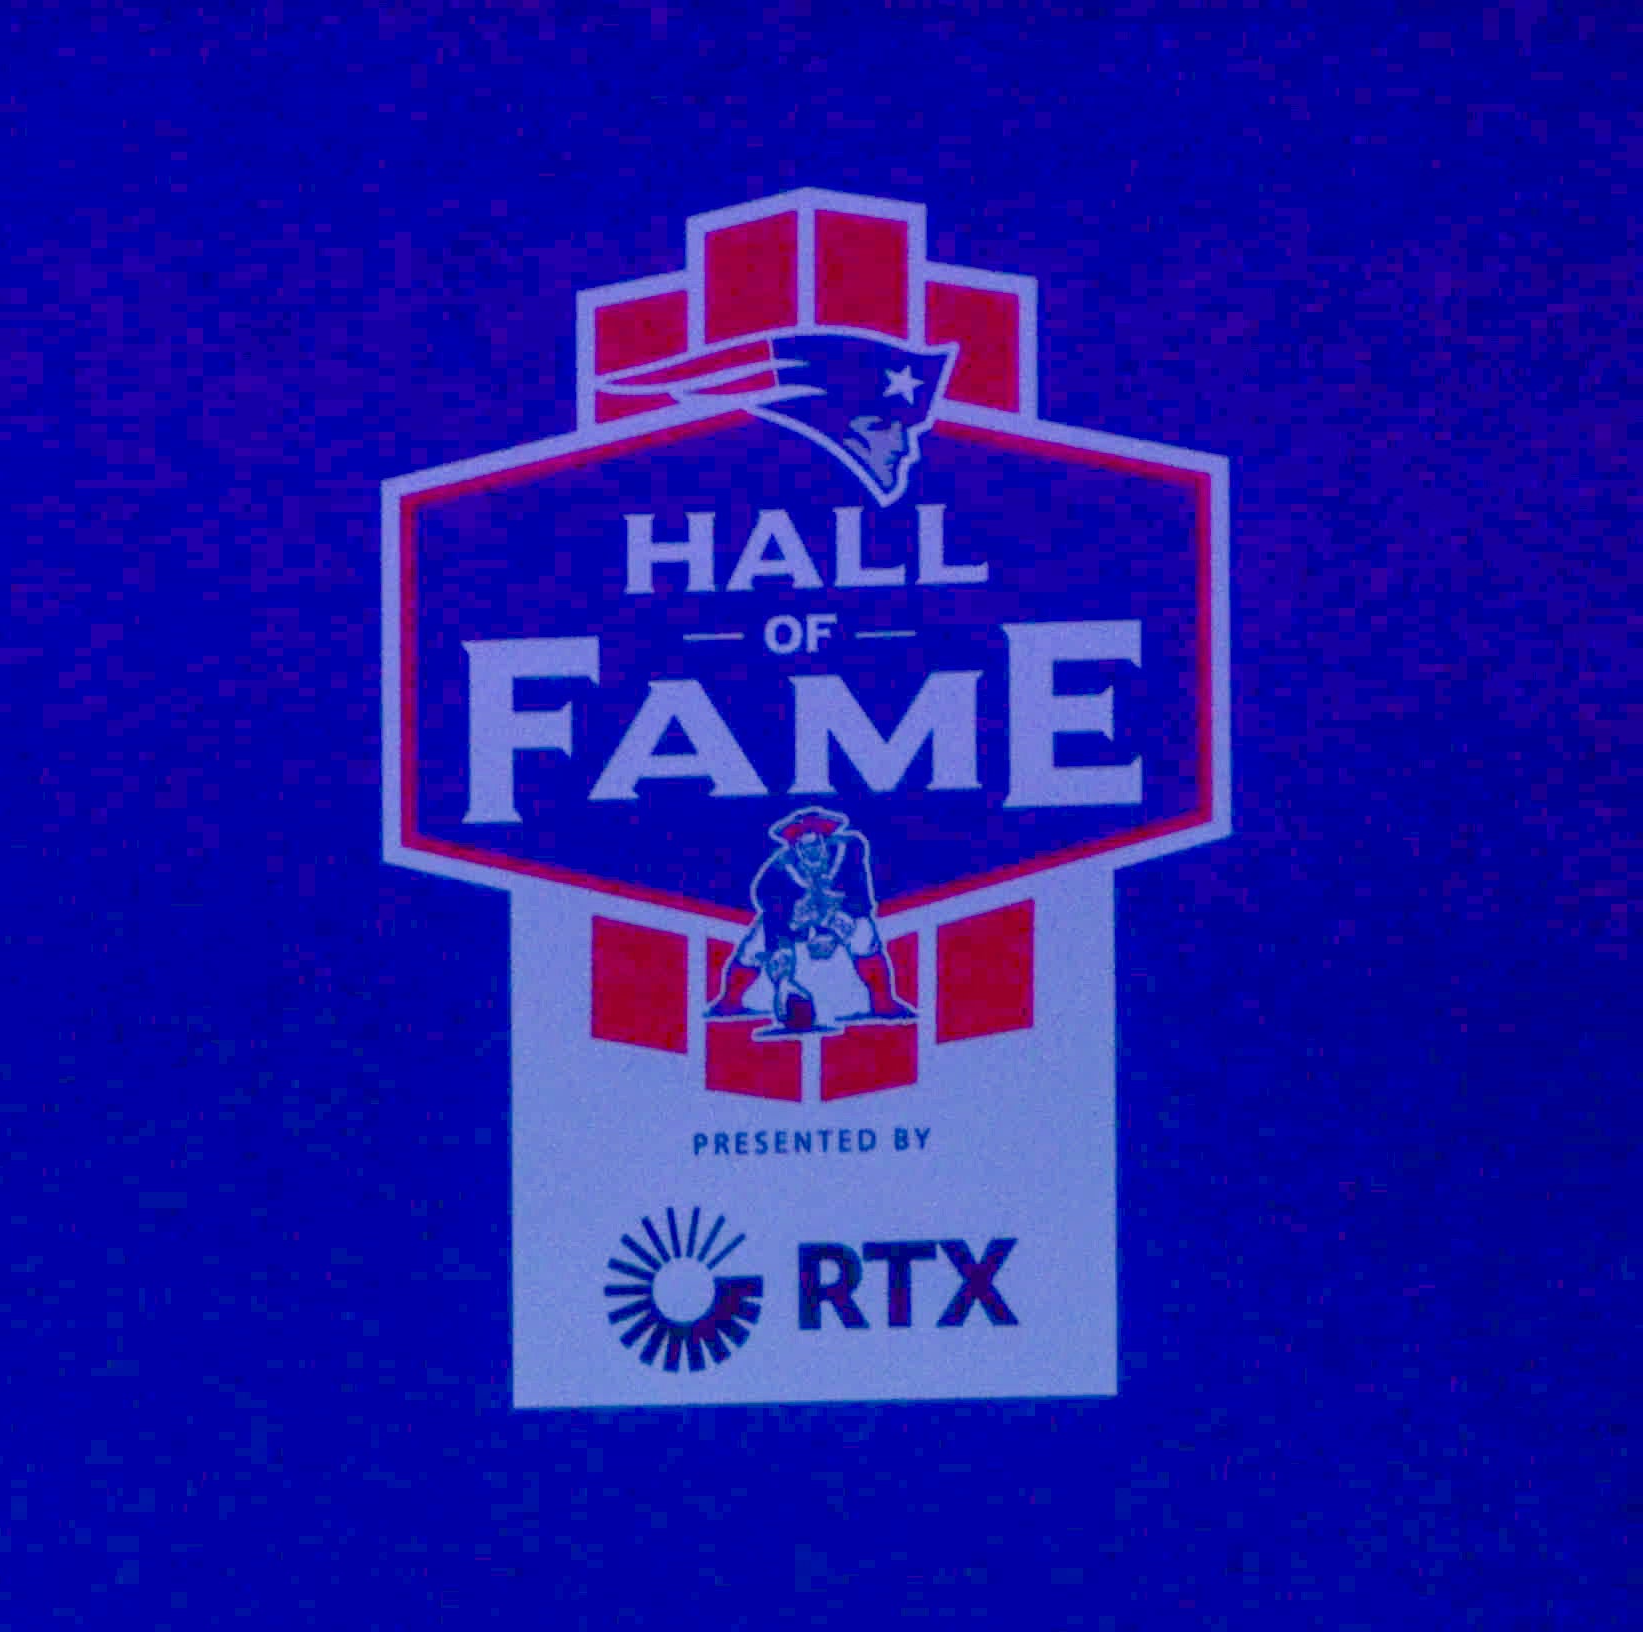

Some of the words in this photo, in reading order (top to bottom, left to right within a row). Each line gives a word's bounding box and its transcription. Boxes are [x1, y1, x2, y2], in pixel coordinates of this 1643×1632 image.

[623, 503, 990, 594] HALL
[763, 612, 839, 655] OF
[460, 618, 1144, 825] FAME
[692, 1128, 878, 1157] PRESENTED
[892, 1126, 933, 1152] BY
[797, 1237, 1020, 1331] RTX
